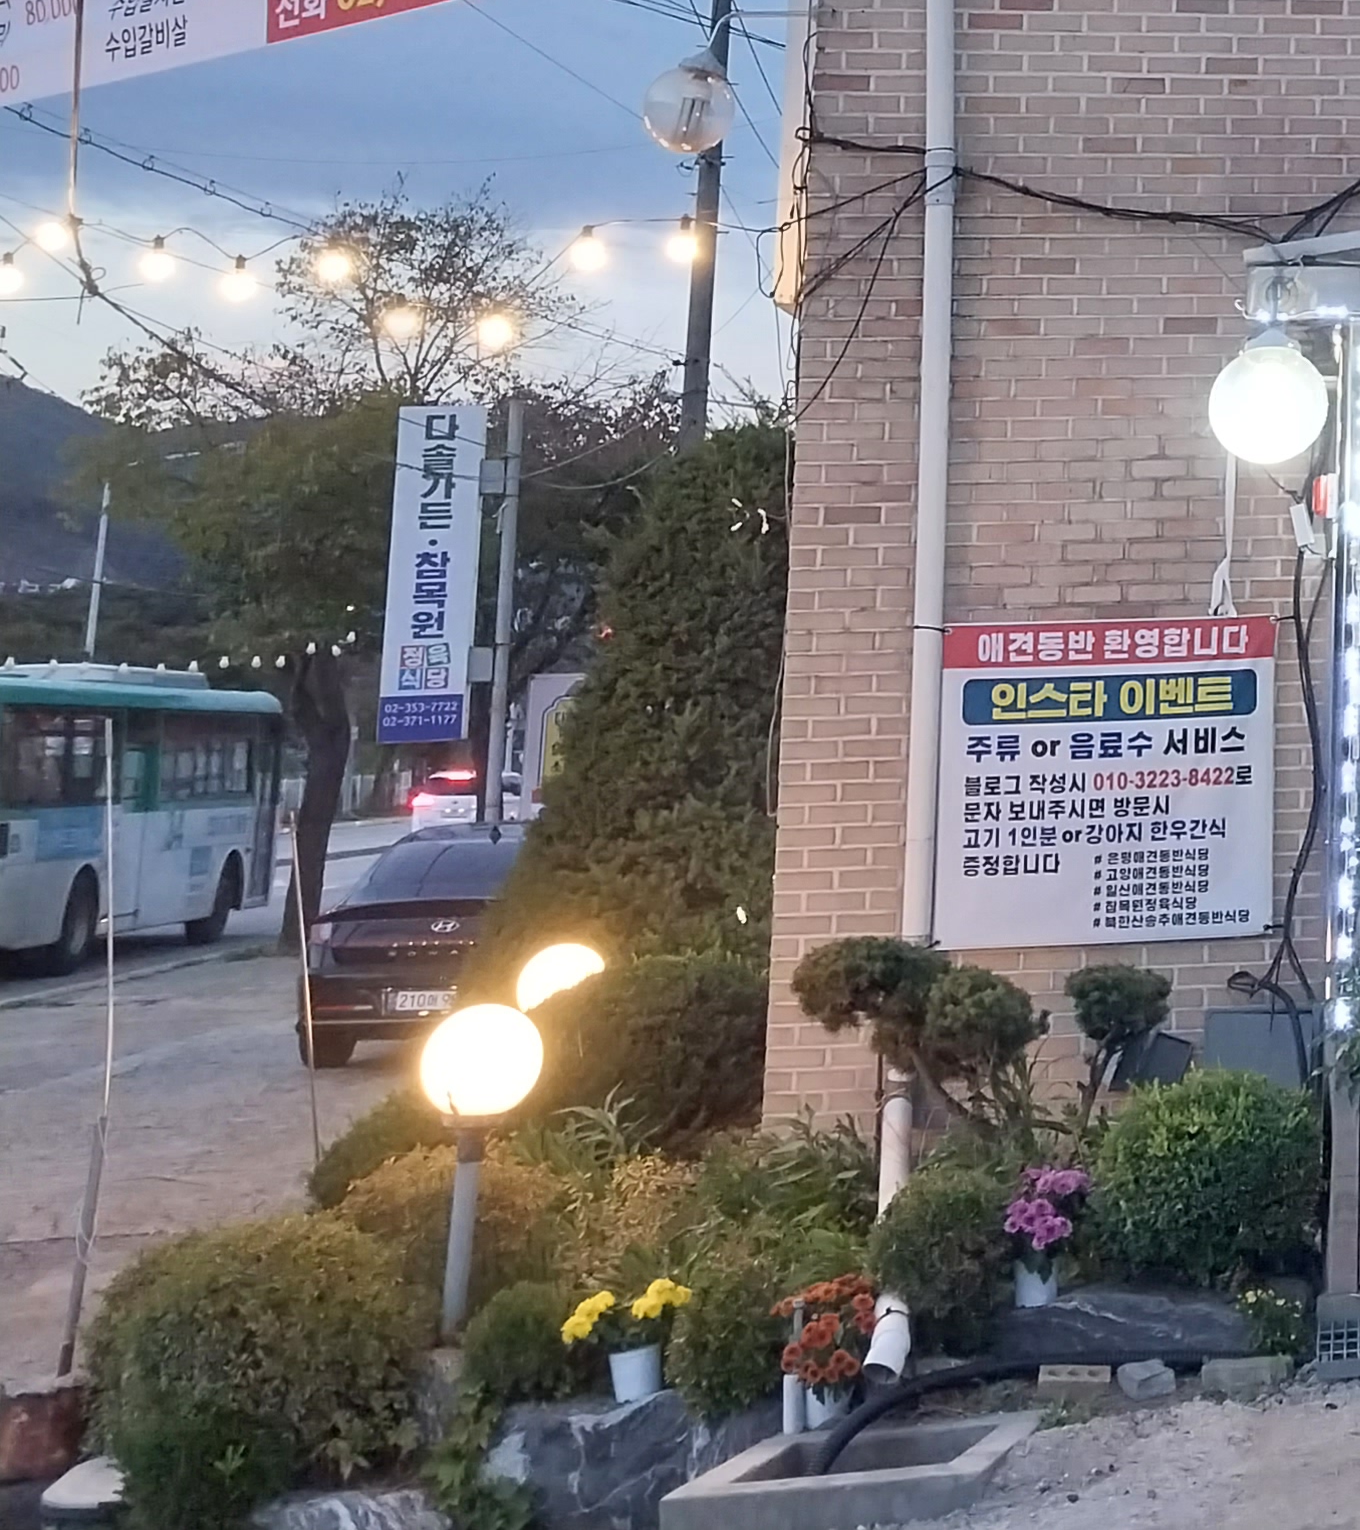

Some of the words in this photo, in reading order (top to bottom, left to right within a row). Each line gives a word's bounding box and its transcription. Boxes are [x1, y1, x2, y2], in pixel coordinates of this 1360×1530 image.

[105, 15, 188, 62] 수입갈비살
[977, 630, 1095, 663] 애견동반
[1102, 624, 1249, 659] 환영합니다
[384, 701, 459, 714] 02-353-7722
[990, 678, 1108, 721] 인스타
[1119, 674, 1234, 716] 이벤트
[382, 714, 457, 727] 02-371-1177
[965, 734, 1022, 763] 주류
[1031, 738, 1061, 758] or
[1069, 731, 1153, 760] 음료수
[1163, 726, 1246, 756] 서비스
[963, 774, 1022, 797] 블로그
[1028, 772, 1087, 795] 작성시
[963, 800, 1002, 823] 문자
[1008, 796, 1106, 822] 보내주시면
[1113, 795, 1171, 818] 방문시
[962, 826, 1001, 849] 고기
[1150, 817, 1227, 840] 한우간식
[962, 852, 1061, 877] 증정합니다
